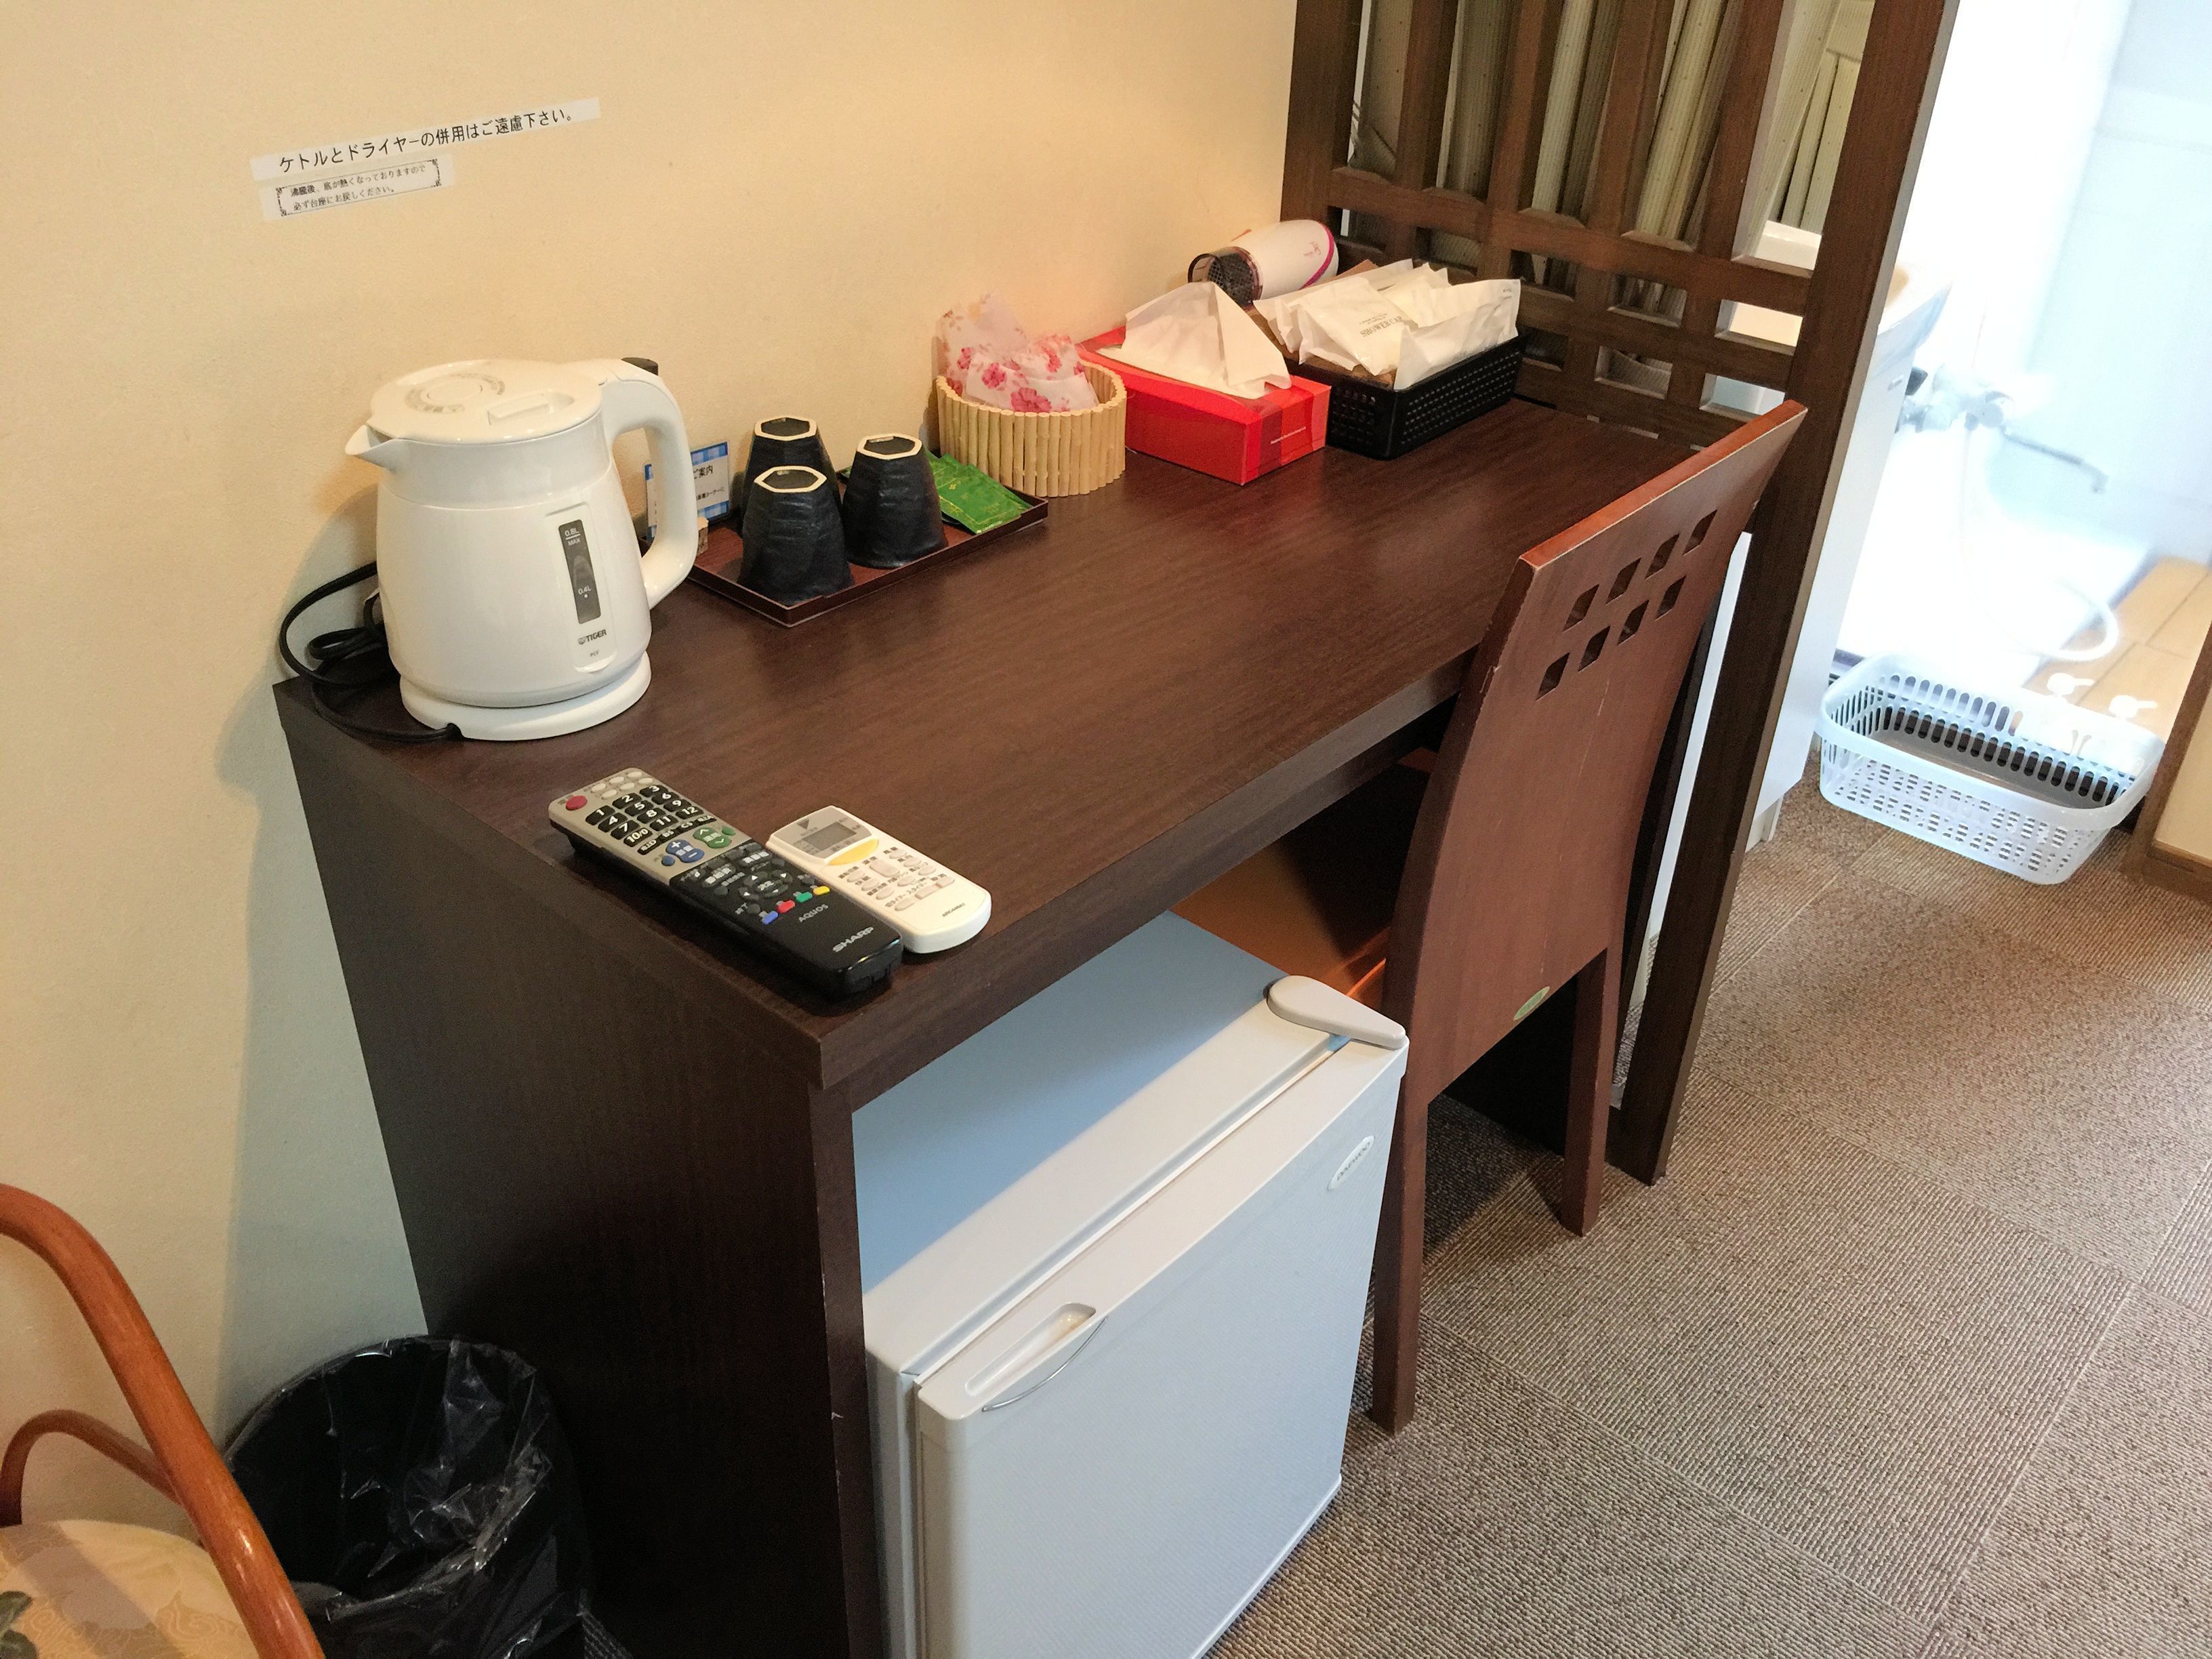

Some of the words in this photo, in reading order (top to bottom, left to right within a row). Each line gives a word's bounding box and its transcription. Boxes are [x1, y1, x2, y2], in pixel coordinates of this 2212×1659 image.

[279, 109, 573, 173] ケトルとドライヤーの併用はご遠慮下さい。
[293, 186, 394, 211] 必ず台座にお戻しください。
[565, 527, 579, 537] 0.8L
[568, 537, 581, 546] MAX
[578, 586, 592, 595] 0.4L
[586, 629, 607, 642] TIGER
[622, 795, 633, 803] 2
[609, 817, 618, 825] 4
[634, 802, 645, 810] 5
[619, 823, 628, 832] 7
[627, 829, 649, 842] 10/0
[657, 816, 671, 825] 11
[682, 806, 698, 815] 12
[798, 903, 829, 923] AQUOS
[832, 926, 874, 952] SHARP
